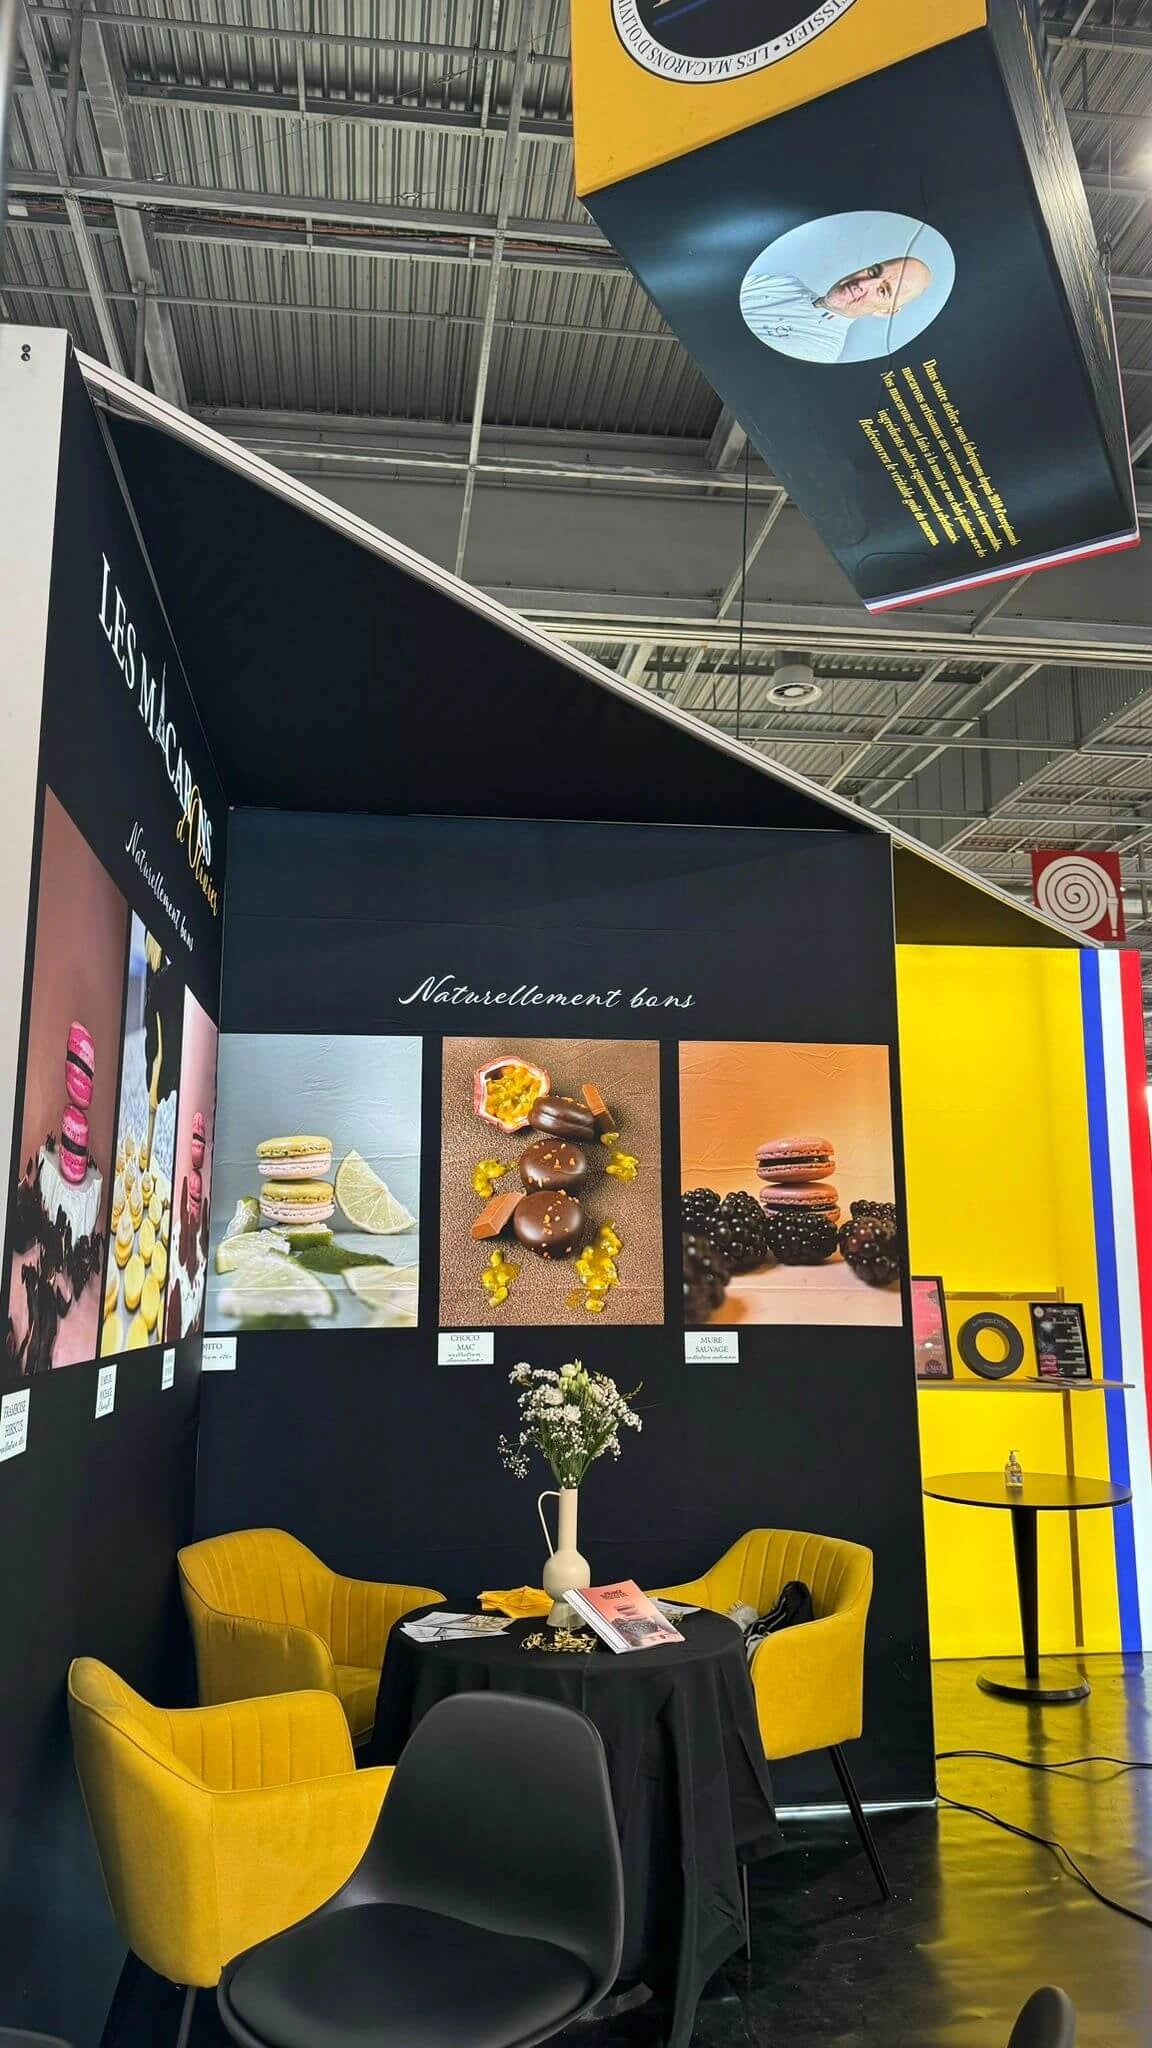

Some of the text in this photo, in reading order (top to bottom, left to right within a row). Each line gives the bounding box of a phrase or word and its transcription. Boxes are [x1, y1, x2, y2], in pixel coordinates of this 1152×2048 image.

[618, 0, 652, 54] D'OLIVI
[646, 47, 732, 76] MACARONS
[736, 46, 769, 70] LES
[877, 409, 905, 447] ingrédients
[900, 447, 917, 468] nobles
[880, 370, 895, 388] Nos
[889, 388, 912, 422] macarons
[907, 422, 923, 438] sont
[916, 437, 930, 452] faits
[930, 464, 945, 480] main
[902, 367, 925, 403] macarons
[920, 403, 944, 439] artisanaux
[945, 452, 962, 475] saveurs
[923, 359, 938, 381] Dans
[932, 381, 948, 402] notre
[942, 402, 959, 426] atelier,
[954, 426, 968, 443] nous
[963, 442, 984, 476] fabriquons
[977, 476, 995, 495] depuis
[859, 419, 891, 463] Redécouvrez
[891, 471, 914, 498] véritable
[98, 551, 138, 690] LES
[125, 821, 181, 930] Naturellement
[398, 974, 697, 1009] Naturellement bons
[456, 1343, 476, 1351] MAC
[695, 1345, 729, 1353] SAUVAGE
